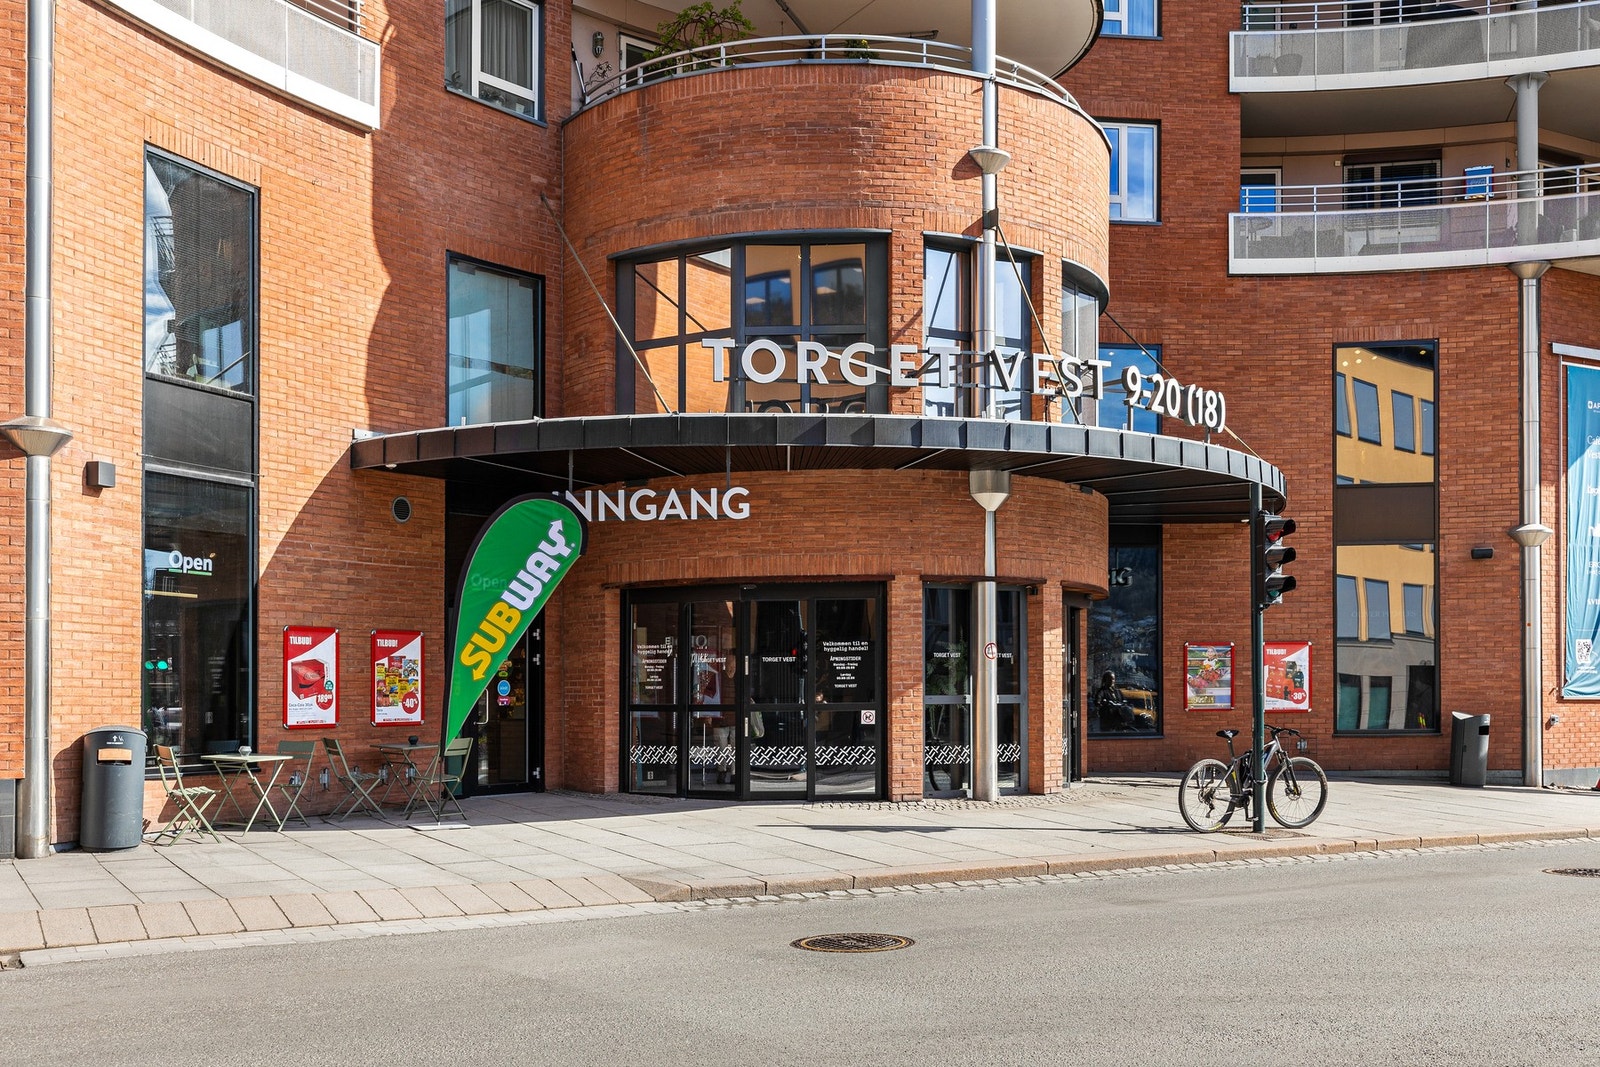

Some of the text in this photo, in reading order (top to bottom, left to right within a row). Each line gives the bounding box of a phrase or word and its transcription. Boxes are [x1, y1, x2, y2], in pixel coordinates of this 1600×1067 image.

[702, 338, 1226, 433] TORGET VEST 9-20 (18)
[551, 487, 751, 522] NNGANG
[168, 550, 213, 573] Open
[459, 519, 573, 682] SUBWAY
[289, 636, 312, 645] TILBUD!
[376, 639, 398, 647] TILBUD!
[1266, 648, 1287, 656] TILBUD!
